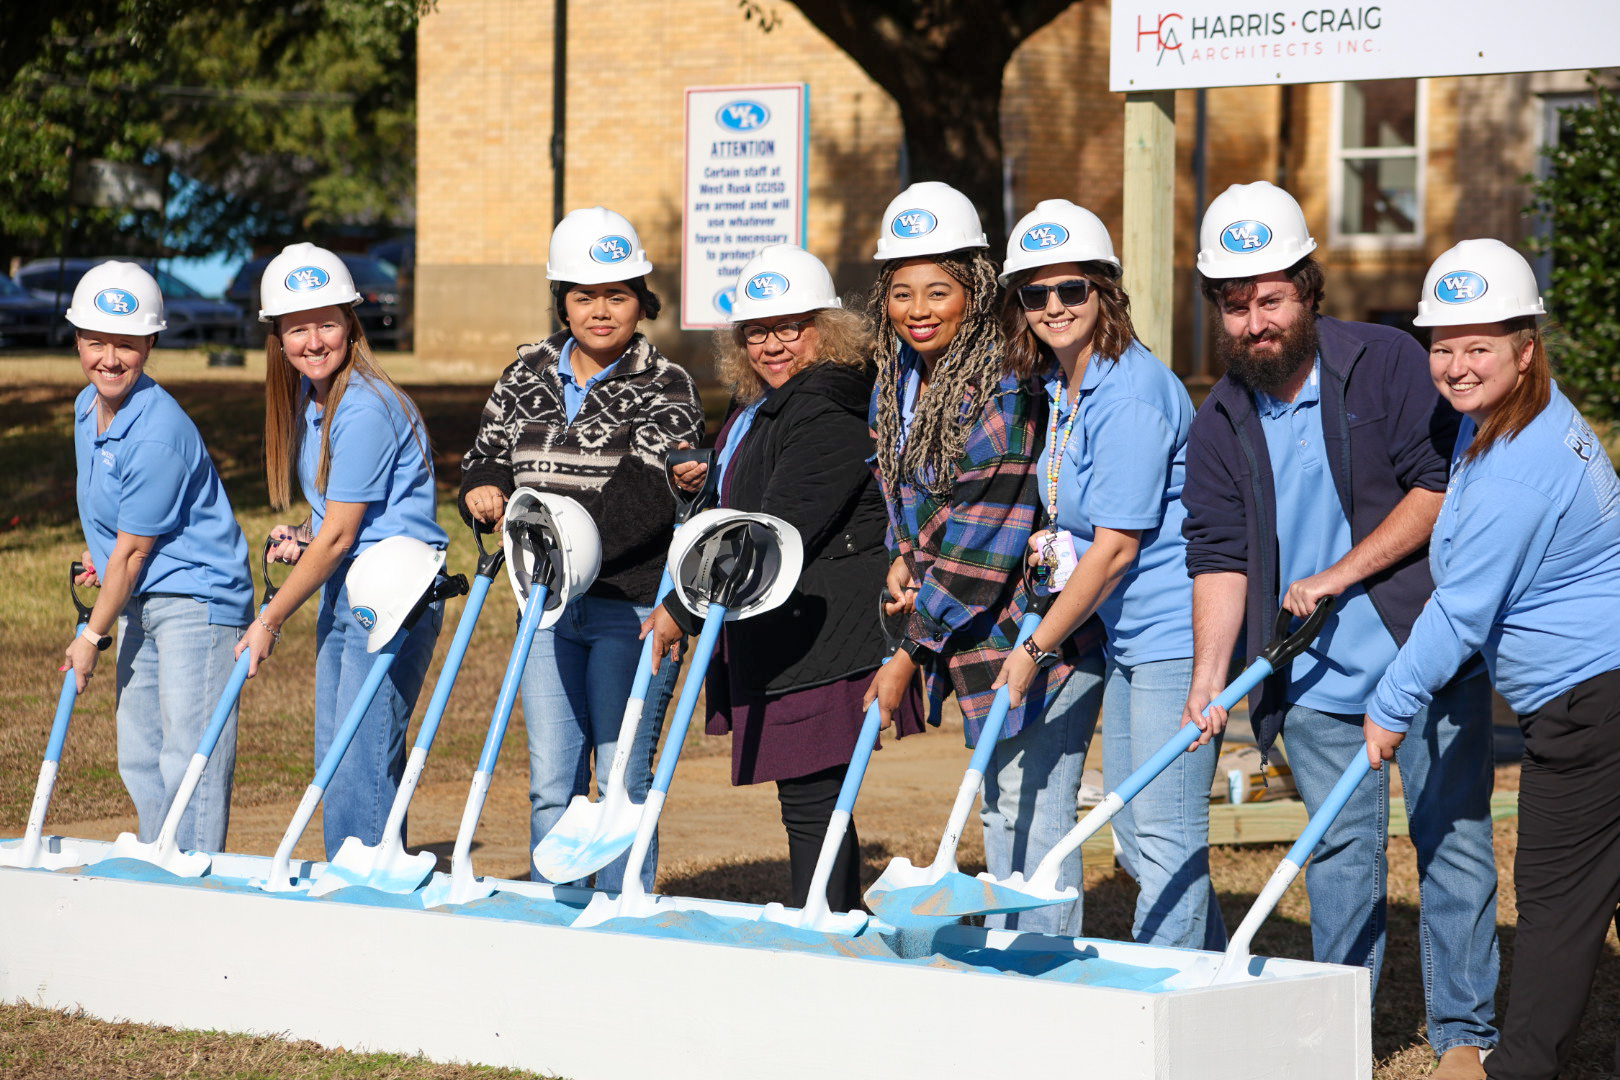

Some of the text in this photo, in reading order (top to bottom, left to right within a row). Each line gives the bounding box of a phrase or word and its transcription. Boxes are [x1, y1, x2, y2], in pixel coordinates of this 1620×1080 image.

[1191, 38, 1382, 61] ARCHITECTS INC.
[711, 140, 775, 158] ATTENTION
[704, 165, 781, 178] Certain staff at
[699, 181, 785, 195] West Rusk CCISD
[695, 198, 789, 211] are armed and will
[707, 216, 775, 228] use whatever
[695, 233, 788, 245] force is necessary
[1028, 227, 1058, 247] WR
[1228, 227, 1262, 249] WR
[598, 240, 626, 260] WR
[706, 248, 756, 262] to protect
[292, 269, 322, 288] WR
[1443, 276, 1476, 299] WR
[104, 292, 129, 313] WR
